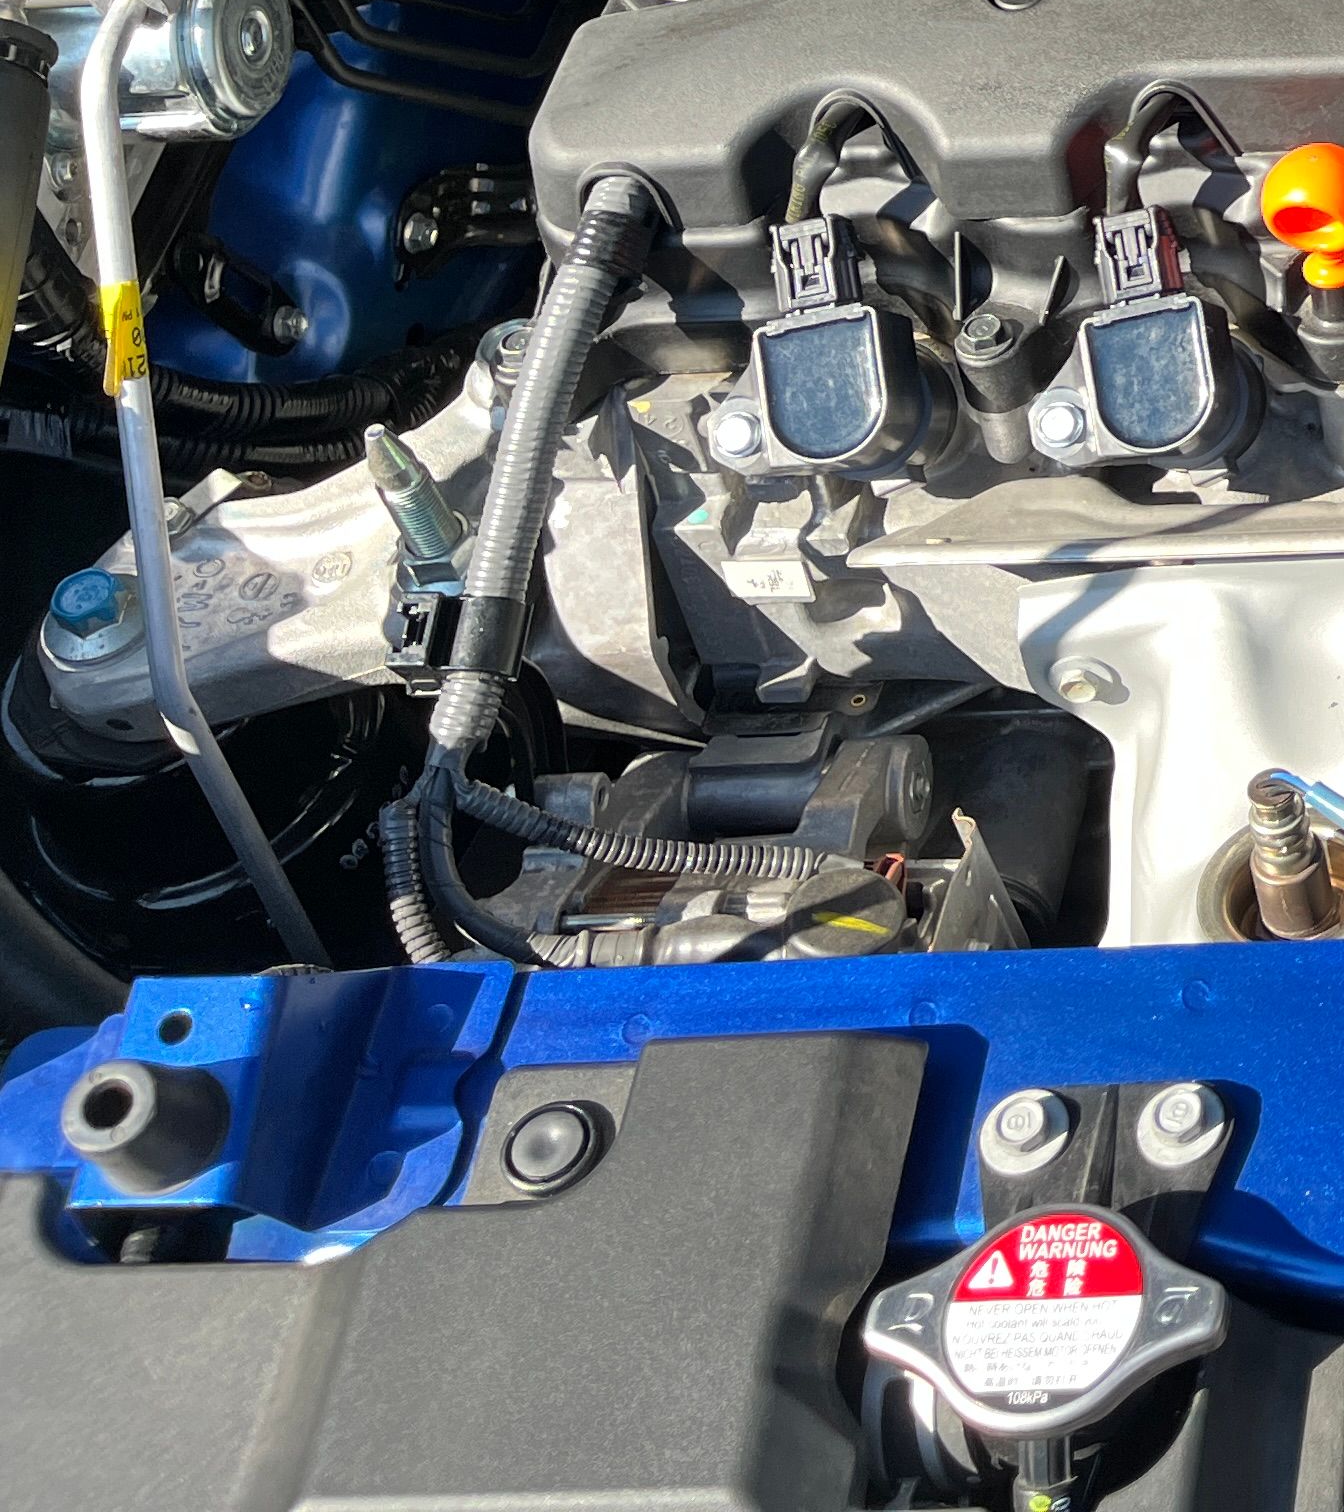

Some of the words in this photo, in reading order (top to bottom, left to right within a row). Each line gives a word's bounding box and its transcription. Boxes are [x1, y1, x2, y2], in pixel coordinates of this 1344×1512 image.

[1021, 1222, 1102, 1242] DANGER
[1019, 1240, 1117, 1260] WARNUNG
[970, 1304, 1010, 1315] NEVER
[1015, 1303, 1048, 1315] OPEN
[1053, 1302, 1088, 1313] WHEN
[1014, 1331, 1035, 1342] PAS
[1008, 1391, 1048, 1405] 108kPa
